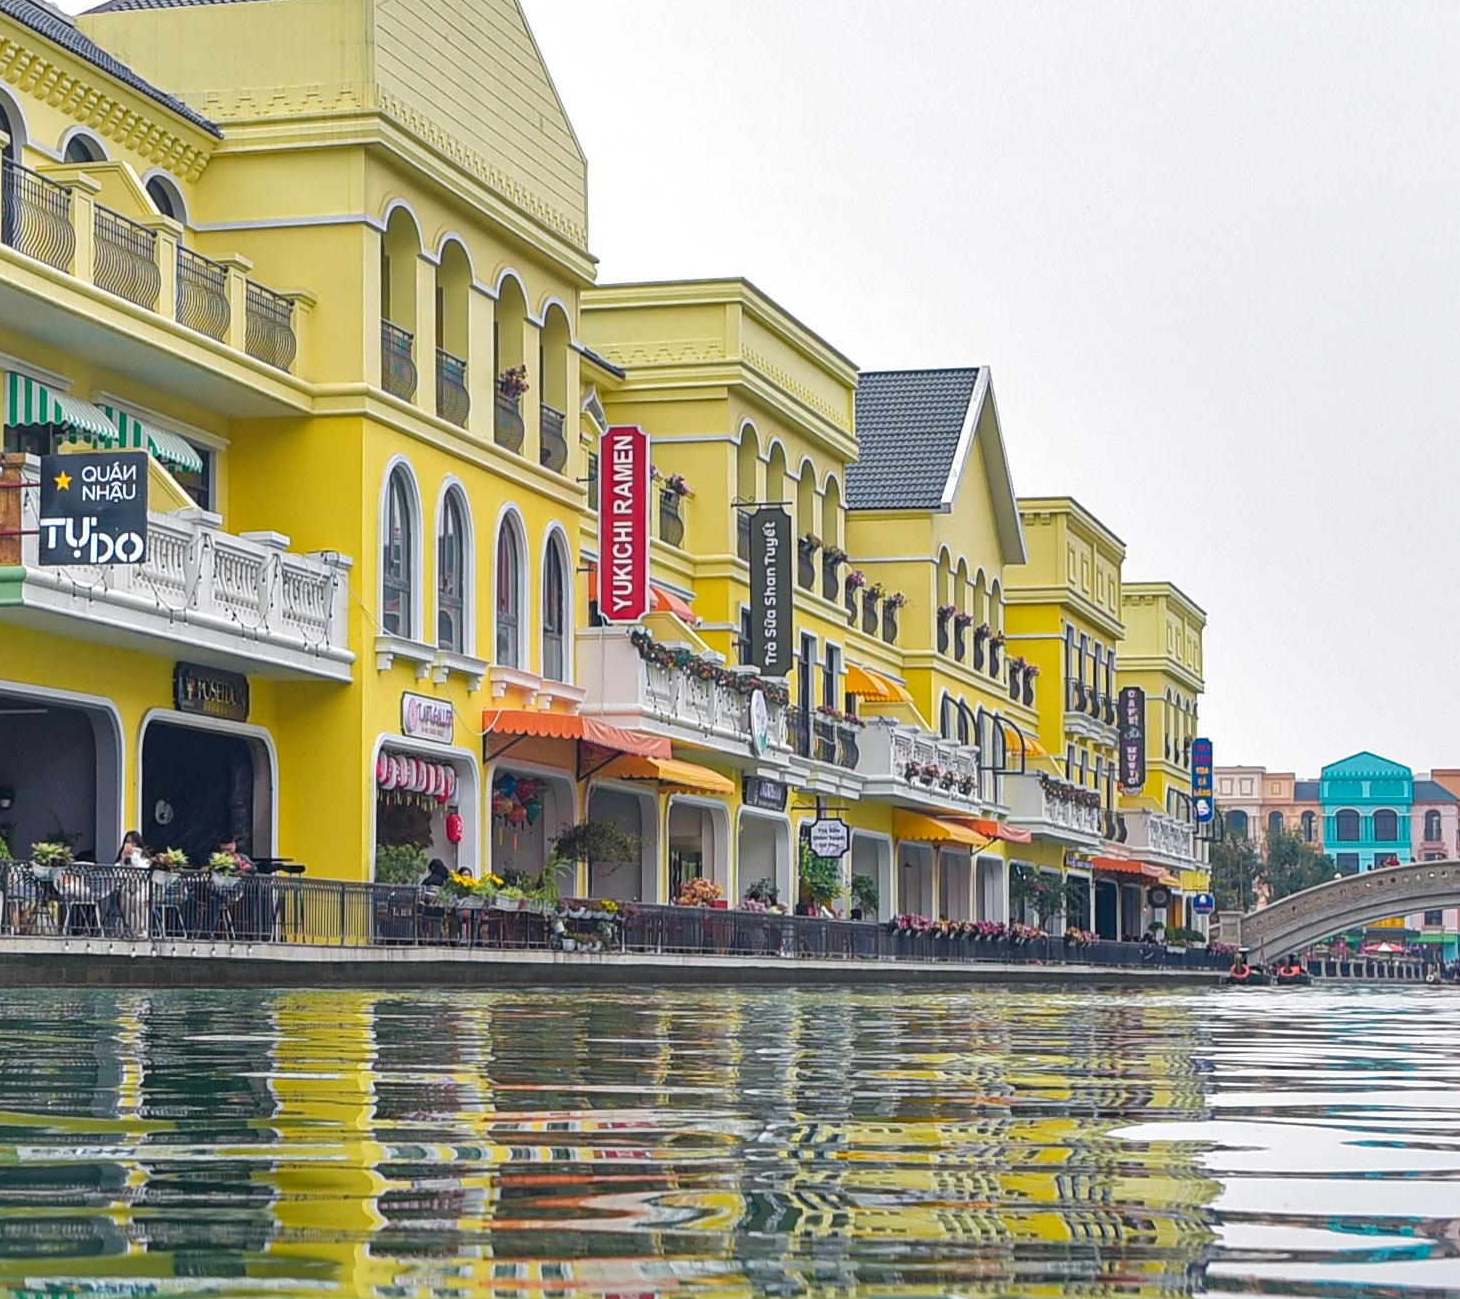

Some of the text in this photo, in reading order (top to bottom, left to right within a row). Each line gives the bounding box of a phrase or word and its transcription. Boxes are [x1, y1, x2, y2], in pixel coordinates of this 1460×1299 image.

[81, 461, 137, 482] QUÁN
[82, 481, 136, 503] NHẬU
[39, 516, 145, 564] TỰ DO
[612, 434, 634, 612] YUKICHI RAMEN
[762, 520, 779, 666] Trà Sữa Shan Tuyết
